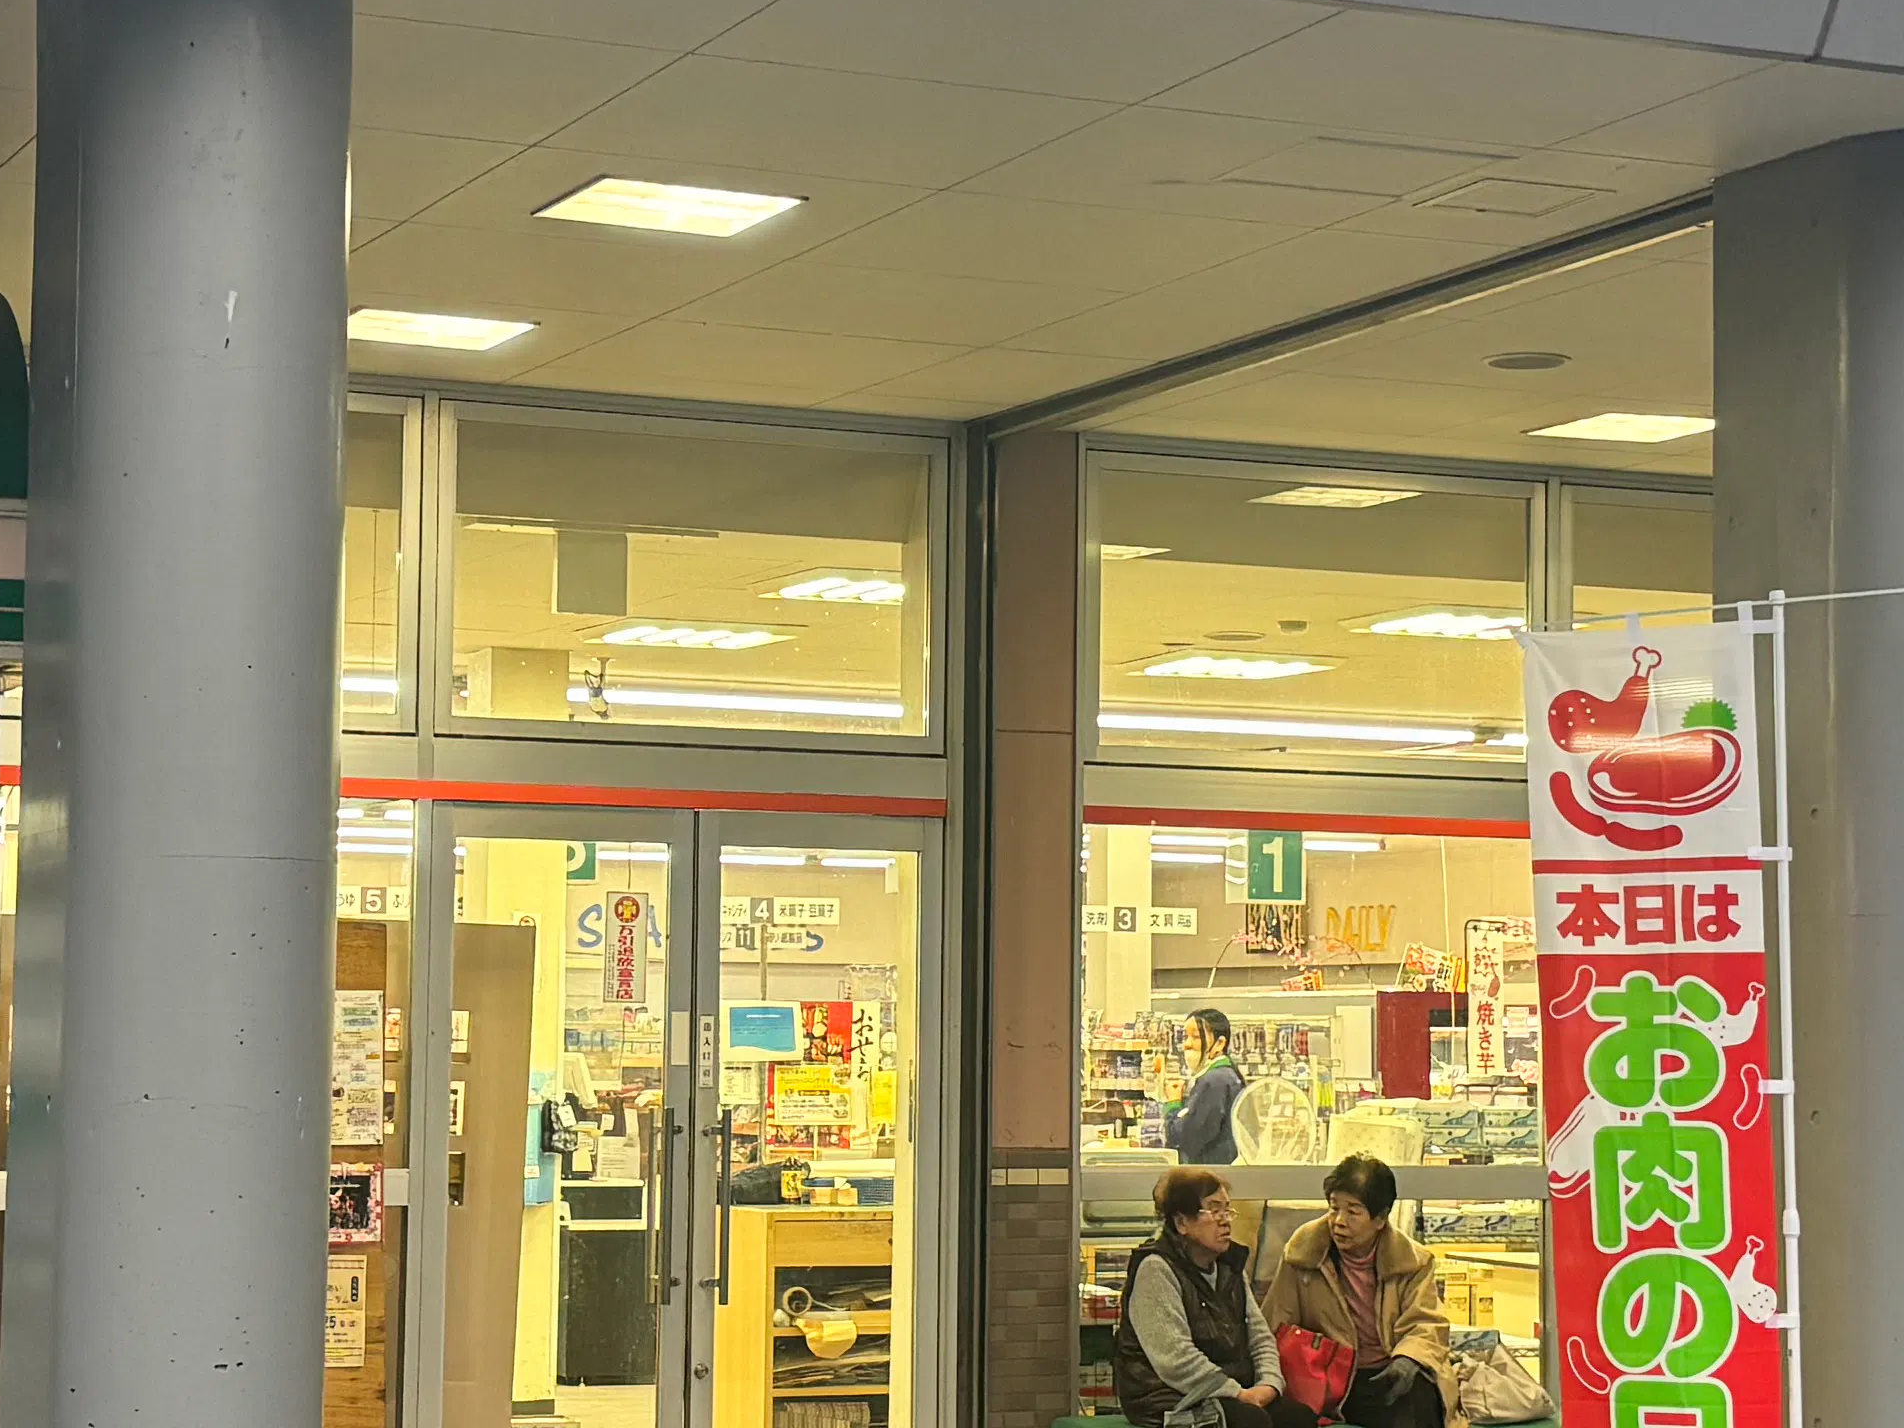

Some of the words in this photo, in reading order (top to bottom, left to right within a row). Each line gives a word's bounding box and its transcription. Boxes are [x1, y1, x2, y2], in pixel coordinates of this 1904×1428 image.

[1261, 836, 1284, 893] 1
[365, 889, 382, 912] 5
[754, 899, 770, 920] 4
[1117, 908, 1132, 930] 3
[1556, 884, 1741, 946] 本日は
[1326, 904, 1397, 952] DAILY
[1476, 1000, 1496, 1075] 焼き芋
